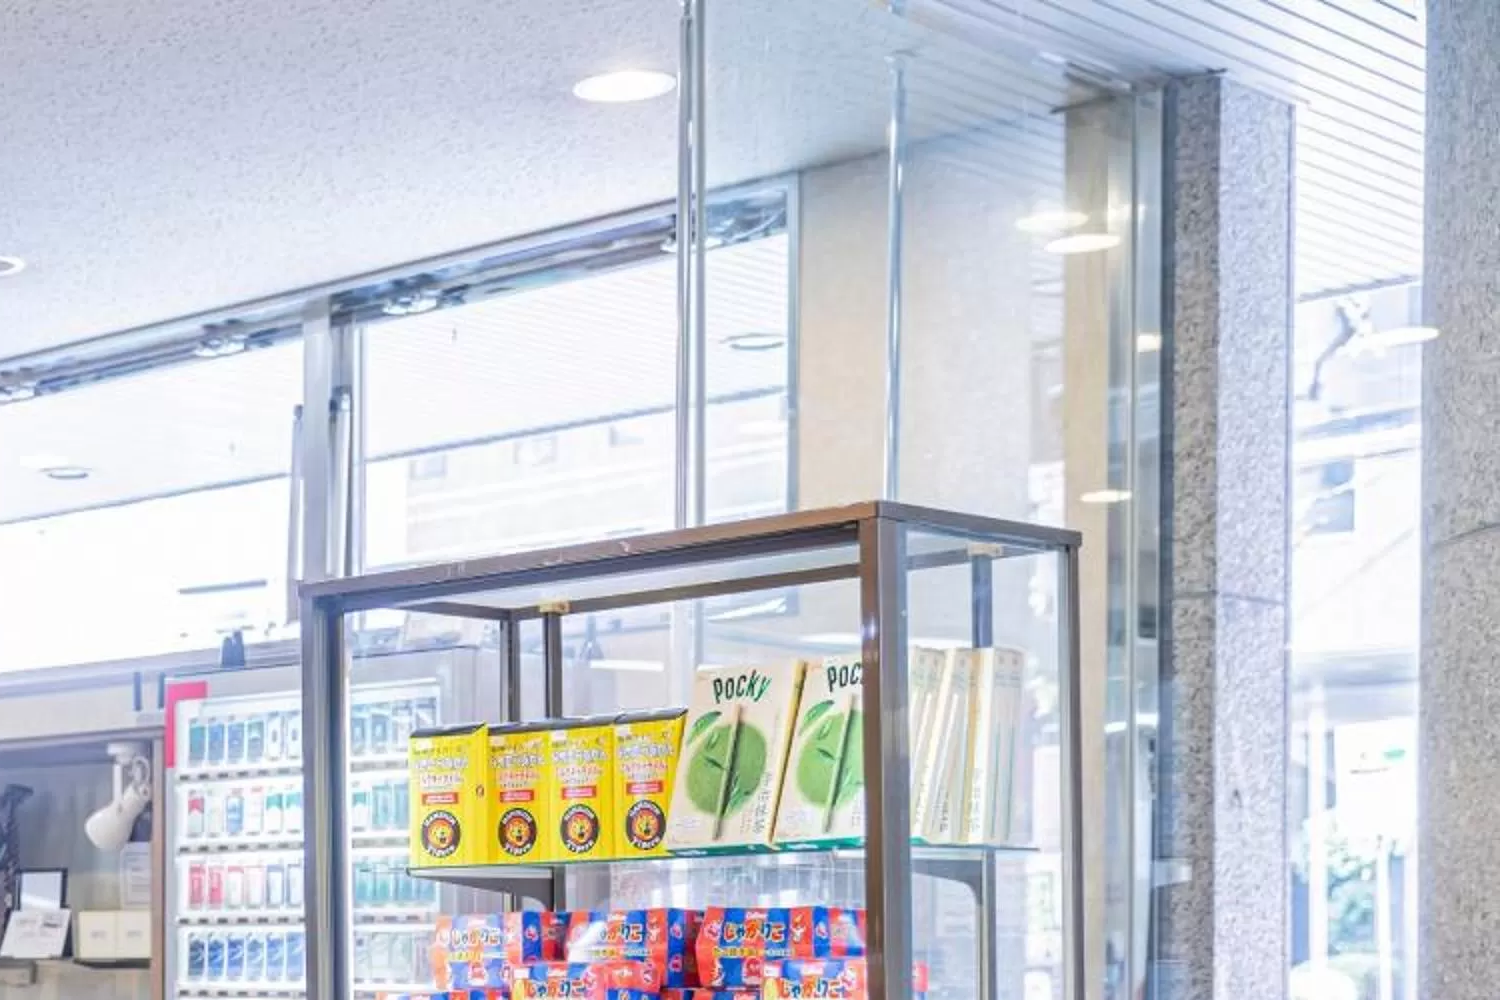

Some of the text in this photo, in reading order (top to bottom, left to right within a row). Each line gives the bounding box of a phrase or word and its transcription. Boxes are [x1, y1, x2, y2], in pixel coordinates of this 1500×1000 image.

[723, 918, 787, 944] じゃがりこ
